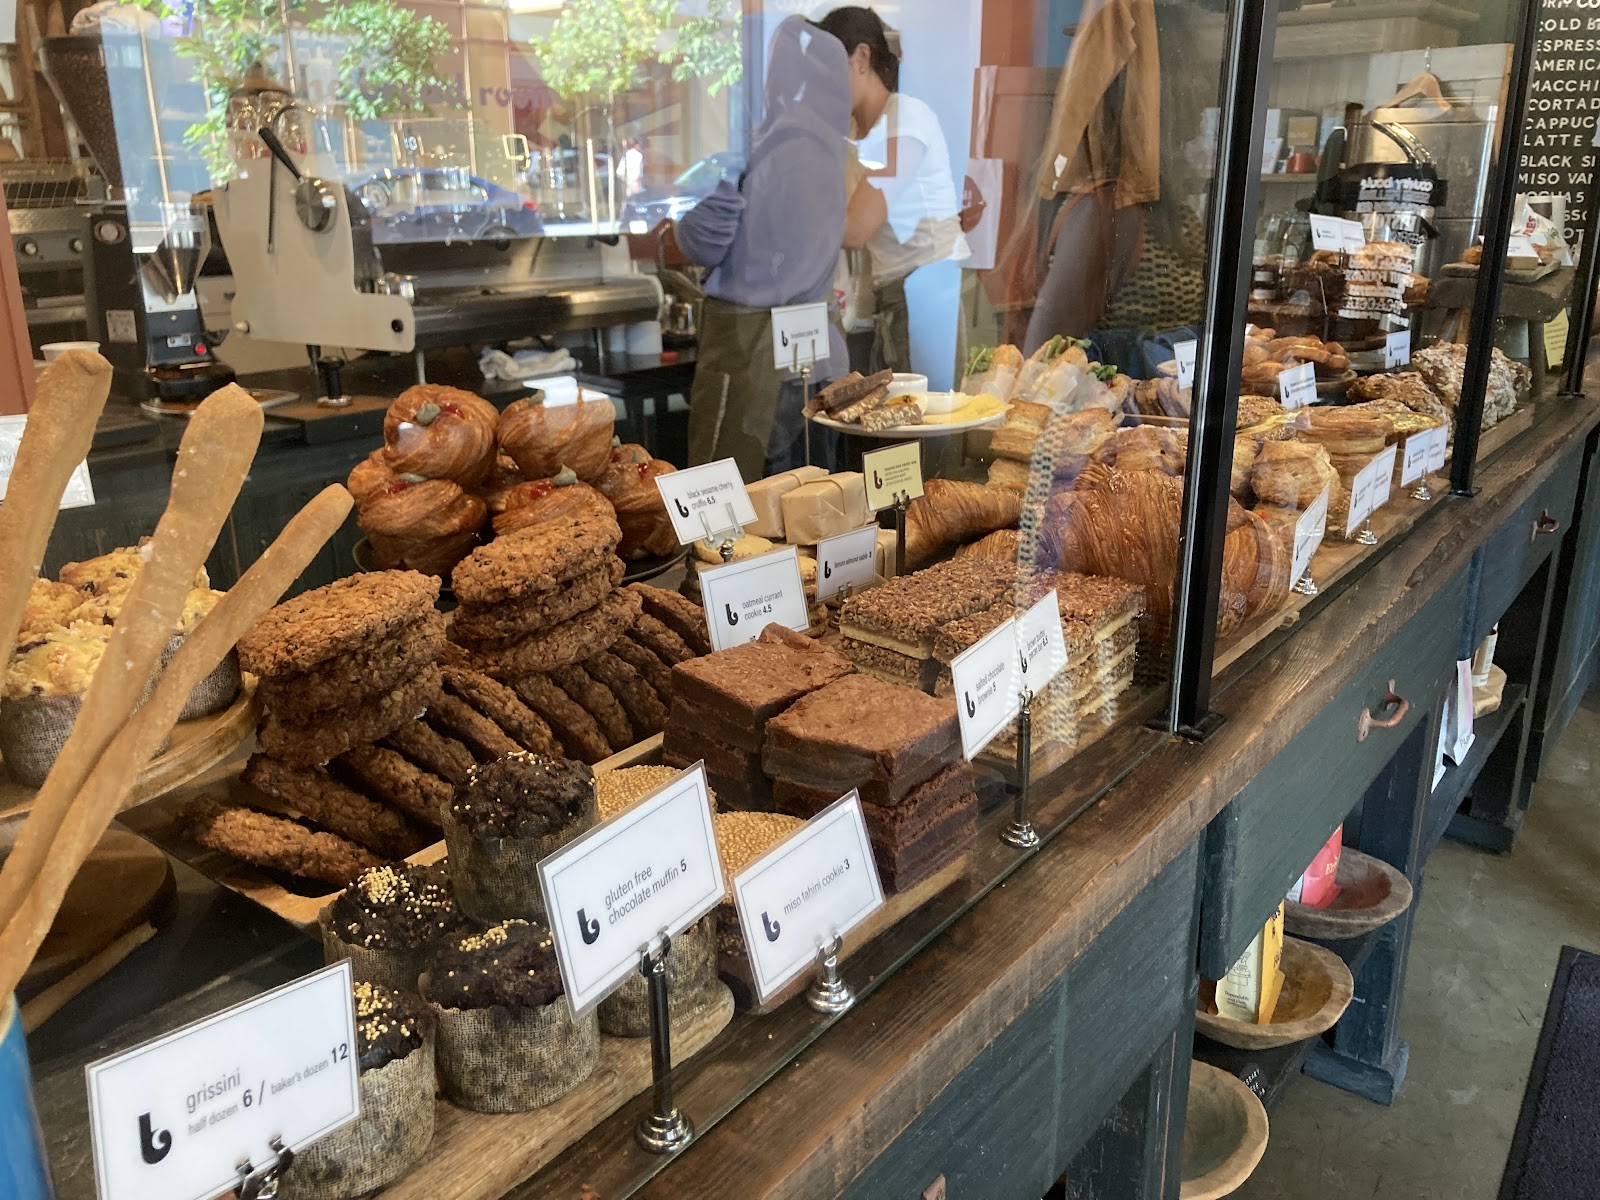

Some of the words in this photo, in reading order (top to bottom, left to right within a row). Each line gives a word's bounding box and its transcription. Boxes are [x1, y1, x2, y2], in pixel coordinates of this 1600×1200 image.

[1524, 134, 1583, 146] LATTE
[1521, 155, 1572, 167] BLACK
[1518, 173, 1560, 184] MISO
[1576, 192, 1584, 203] 5
[742, 595, 763, 609] oatmeal
[764, 590, 783, 602] currant
[745, 608, 762, 620] cookie
[763, 604, 772, 613] 4.5
[976, 673, 987, 691] salted
[988, 662, 1005, 681] chocolate
[977, 686, 993, 704] brownie
[605, 880, 633, 910] gluten
[634, 866, 652, 885] free
[608, 886, 651, 925] chocolate
[652, 867, 679, 893] muffin
[681, 859, 687, 872] 5
[784, 897, 801, 915] miso
[802, 879, 822, 900] tahini
[822, 865, 844, 886] cookie
[844, 858, 850, 870] 3
[186, 1067, 240, 1114] grissini
[188, 1116, 207, 1136] half
[209, 1104, 238, 1125] dozen
[243, 1089, 252, 1107] 6
[259, 1080, 265, 1105] /
[271, 1072, 302, 1095] baker's
[303, 1059, 328, 1079] dozen
[331, 1043, 348, 1063] 12
